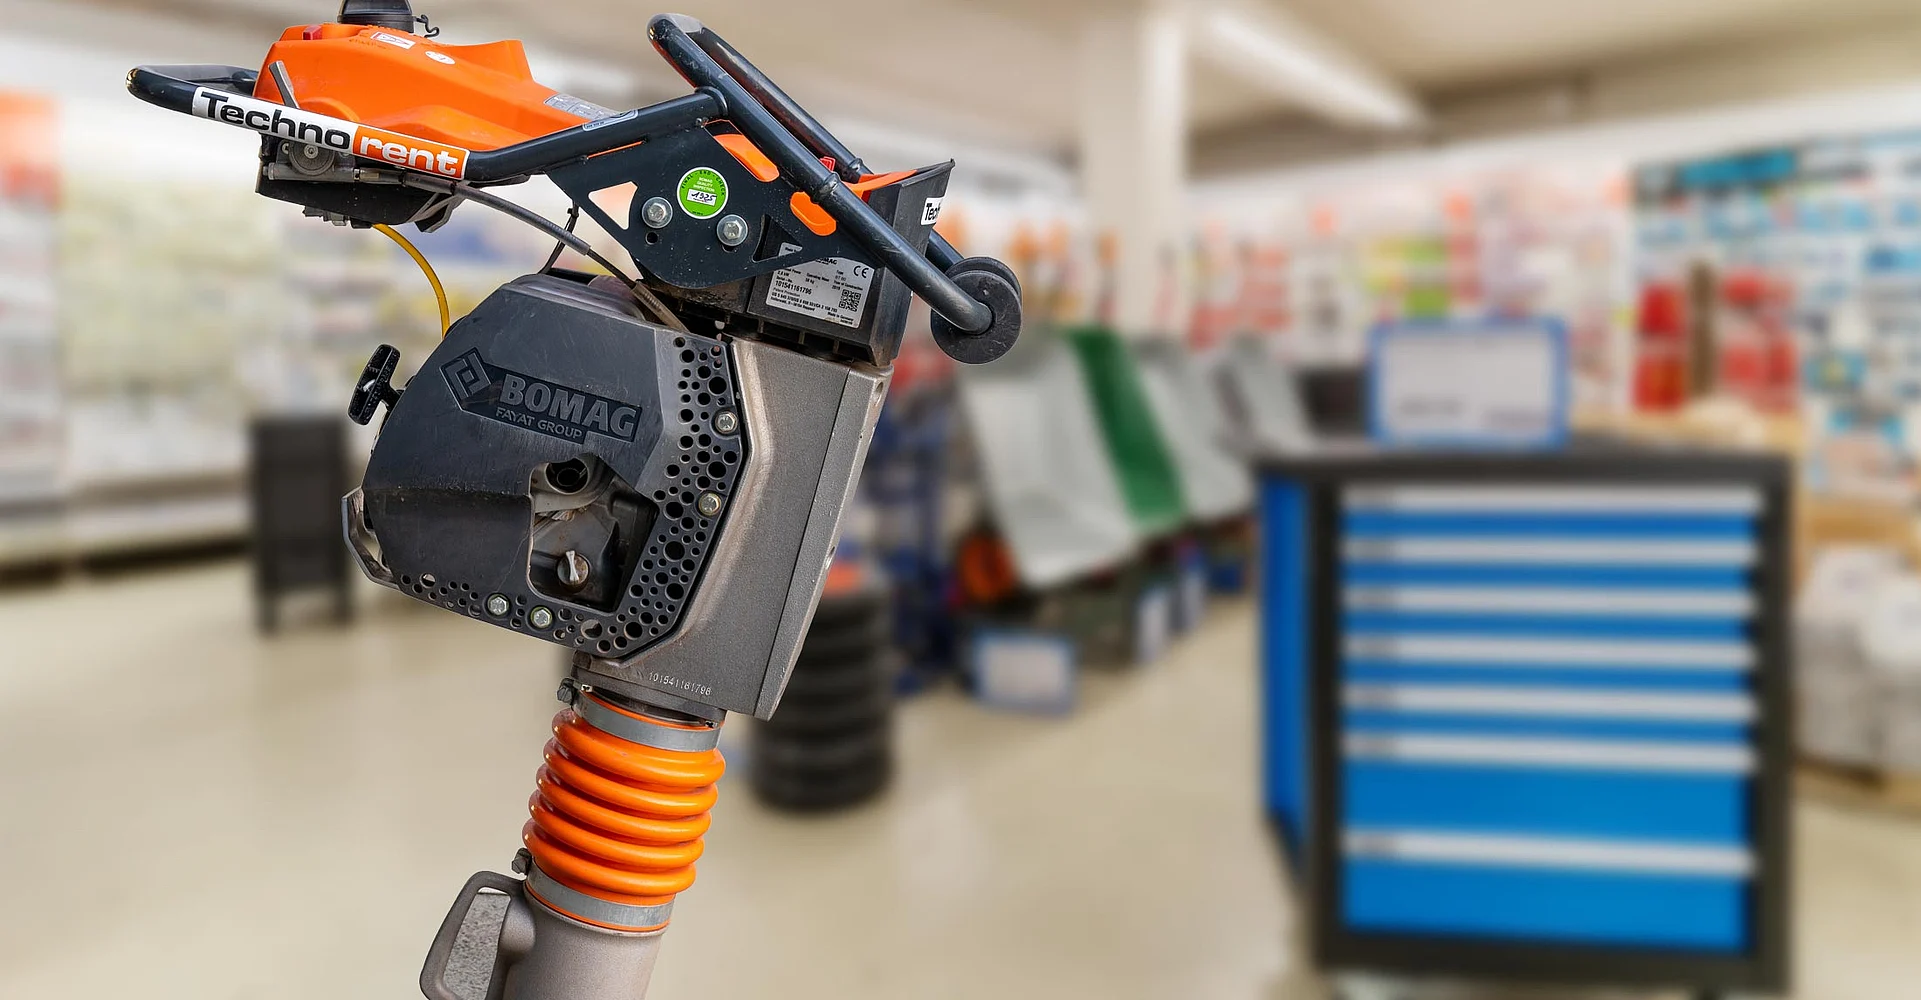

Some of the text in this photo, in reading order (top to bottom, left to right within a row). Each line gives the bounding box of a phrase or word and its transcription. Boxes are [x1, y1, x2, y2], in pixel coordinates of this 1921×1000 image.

[201, 91, 458, 176] Techno rent
[495, 407, 583, 439] FAYAT GROUP
[500, 373, 637, 437] BOMAG
